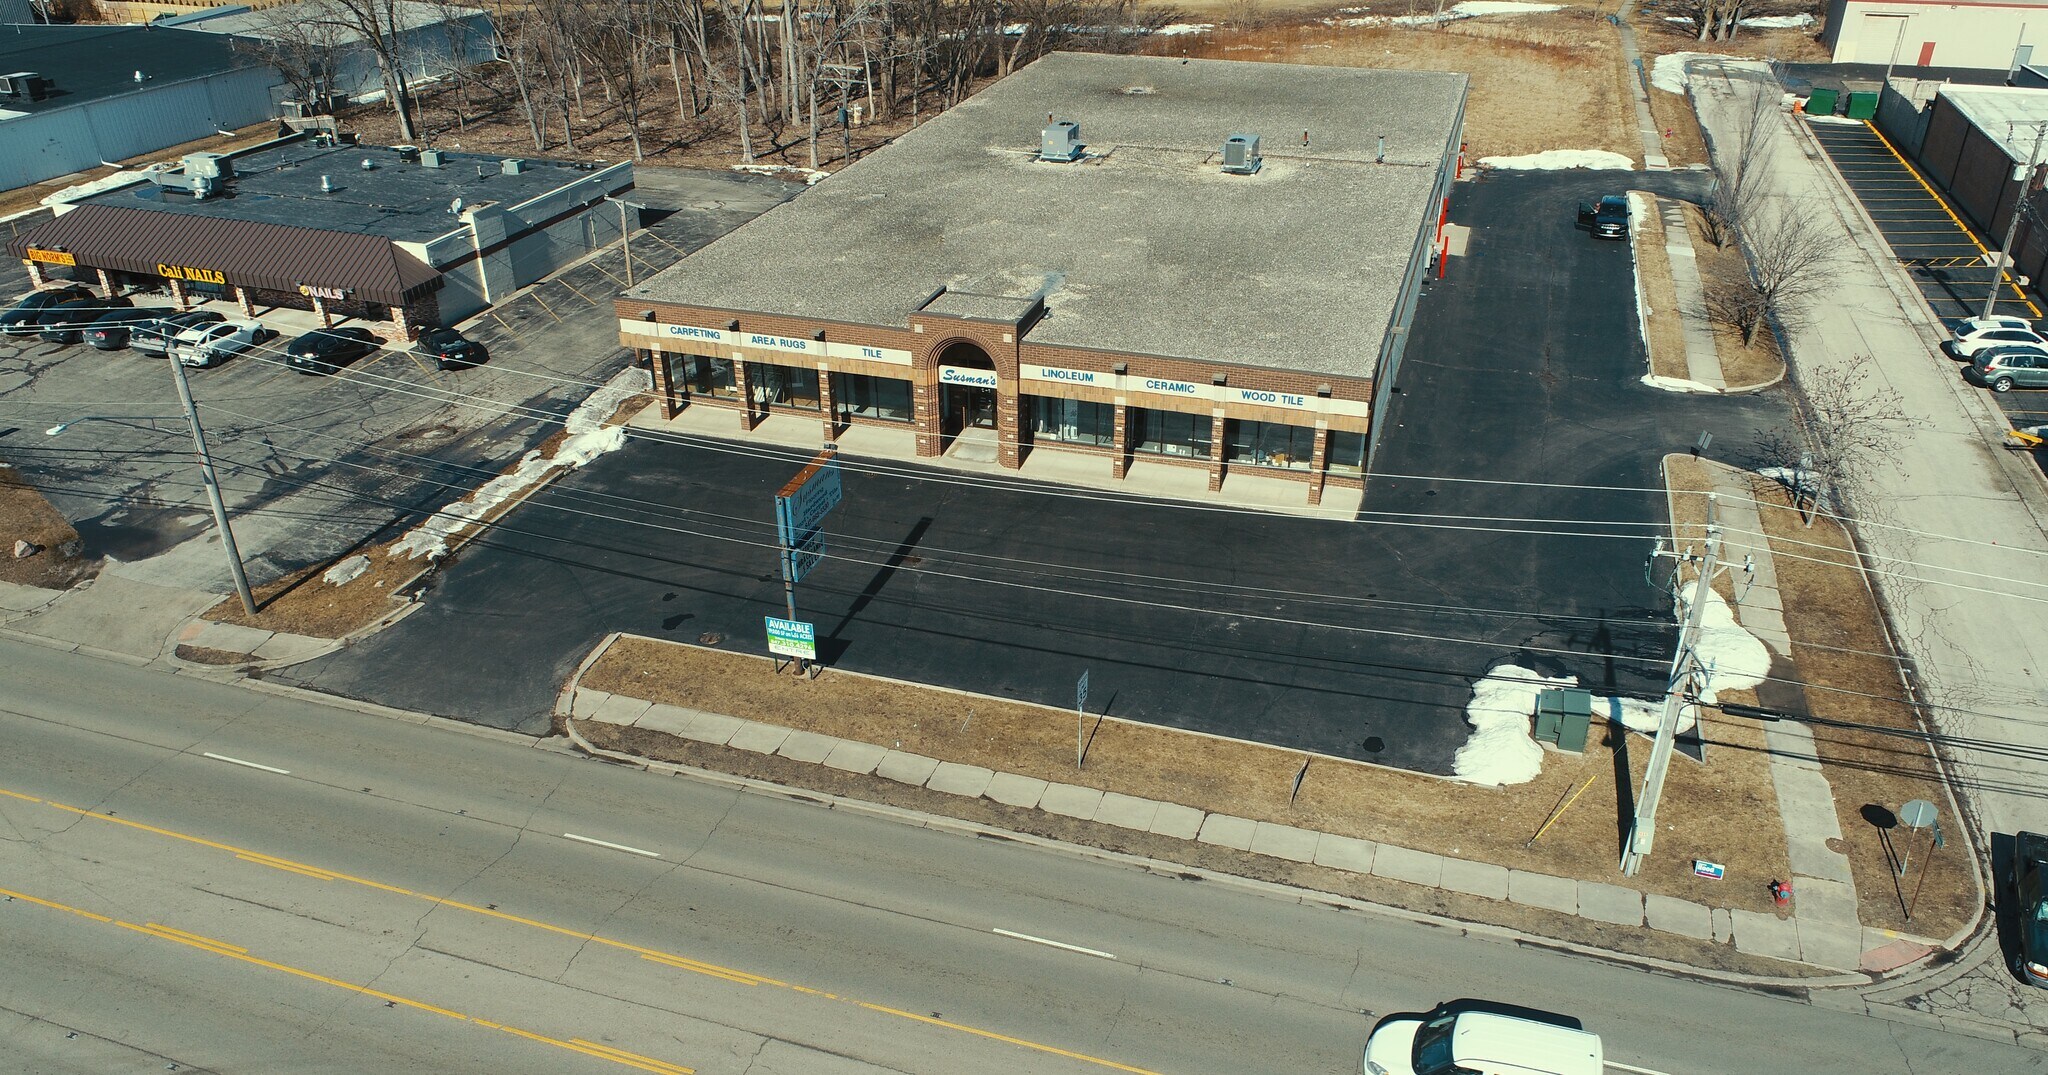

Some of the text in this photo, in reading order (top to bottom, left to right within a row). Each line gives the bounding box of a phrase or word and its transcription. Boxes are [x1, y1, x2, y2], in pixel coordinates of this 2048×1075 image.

[30, 250, 41, 260] BIG
[157, 263, 226, 285] Cali NAILS
[308, 286, 344, 300] NAILS
[670, 326, 721, 340] CARPETING
[751, 335, 806, 349] AREA RUGS
[862, 348, 882, 359] TILE
[942, 369, 997, 386] Susman's
[1042, 368, 1094, 382] LINOLEUM
[1146, 380, 1195, 393] CERAMIC
[1241, 390, 1304, 406] WOOD TILE
[769, 620, 811, 634] AVAILABLE
